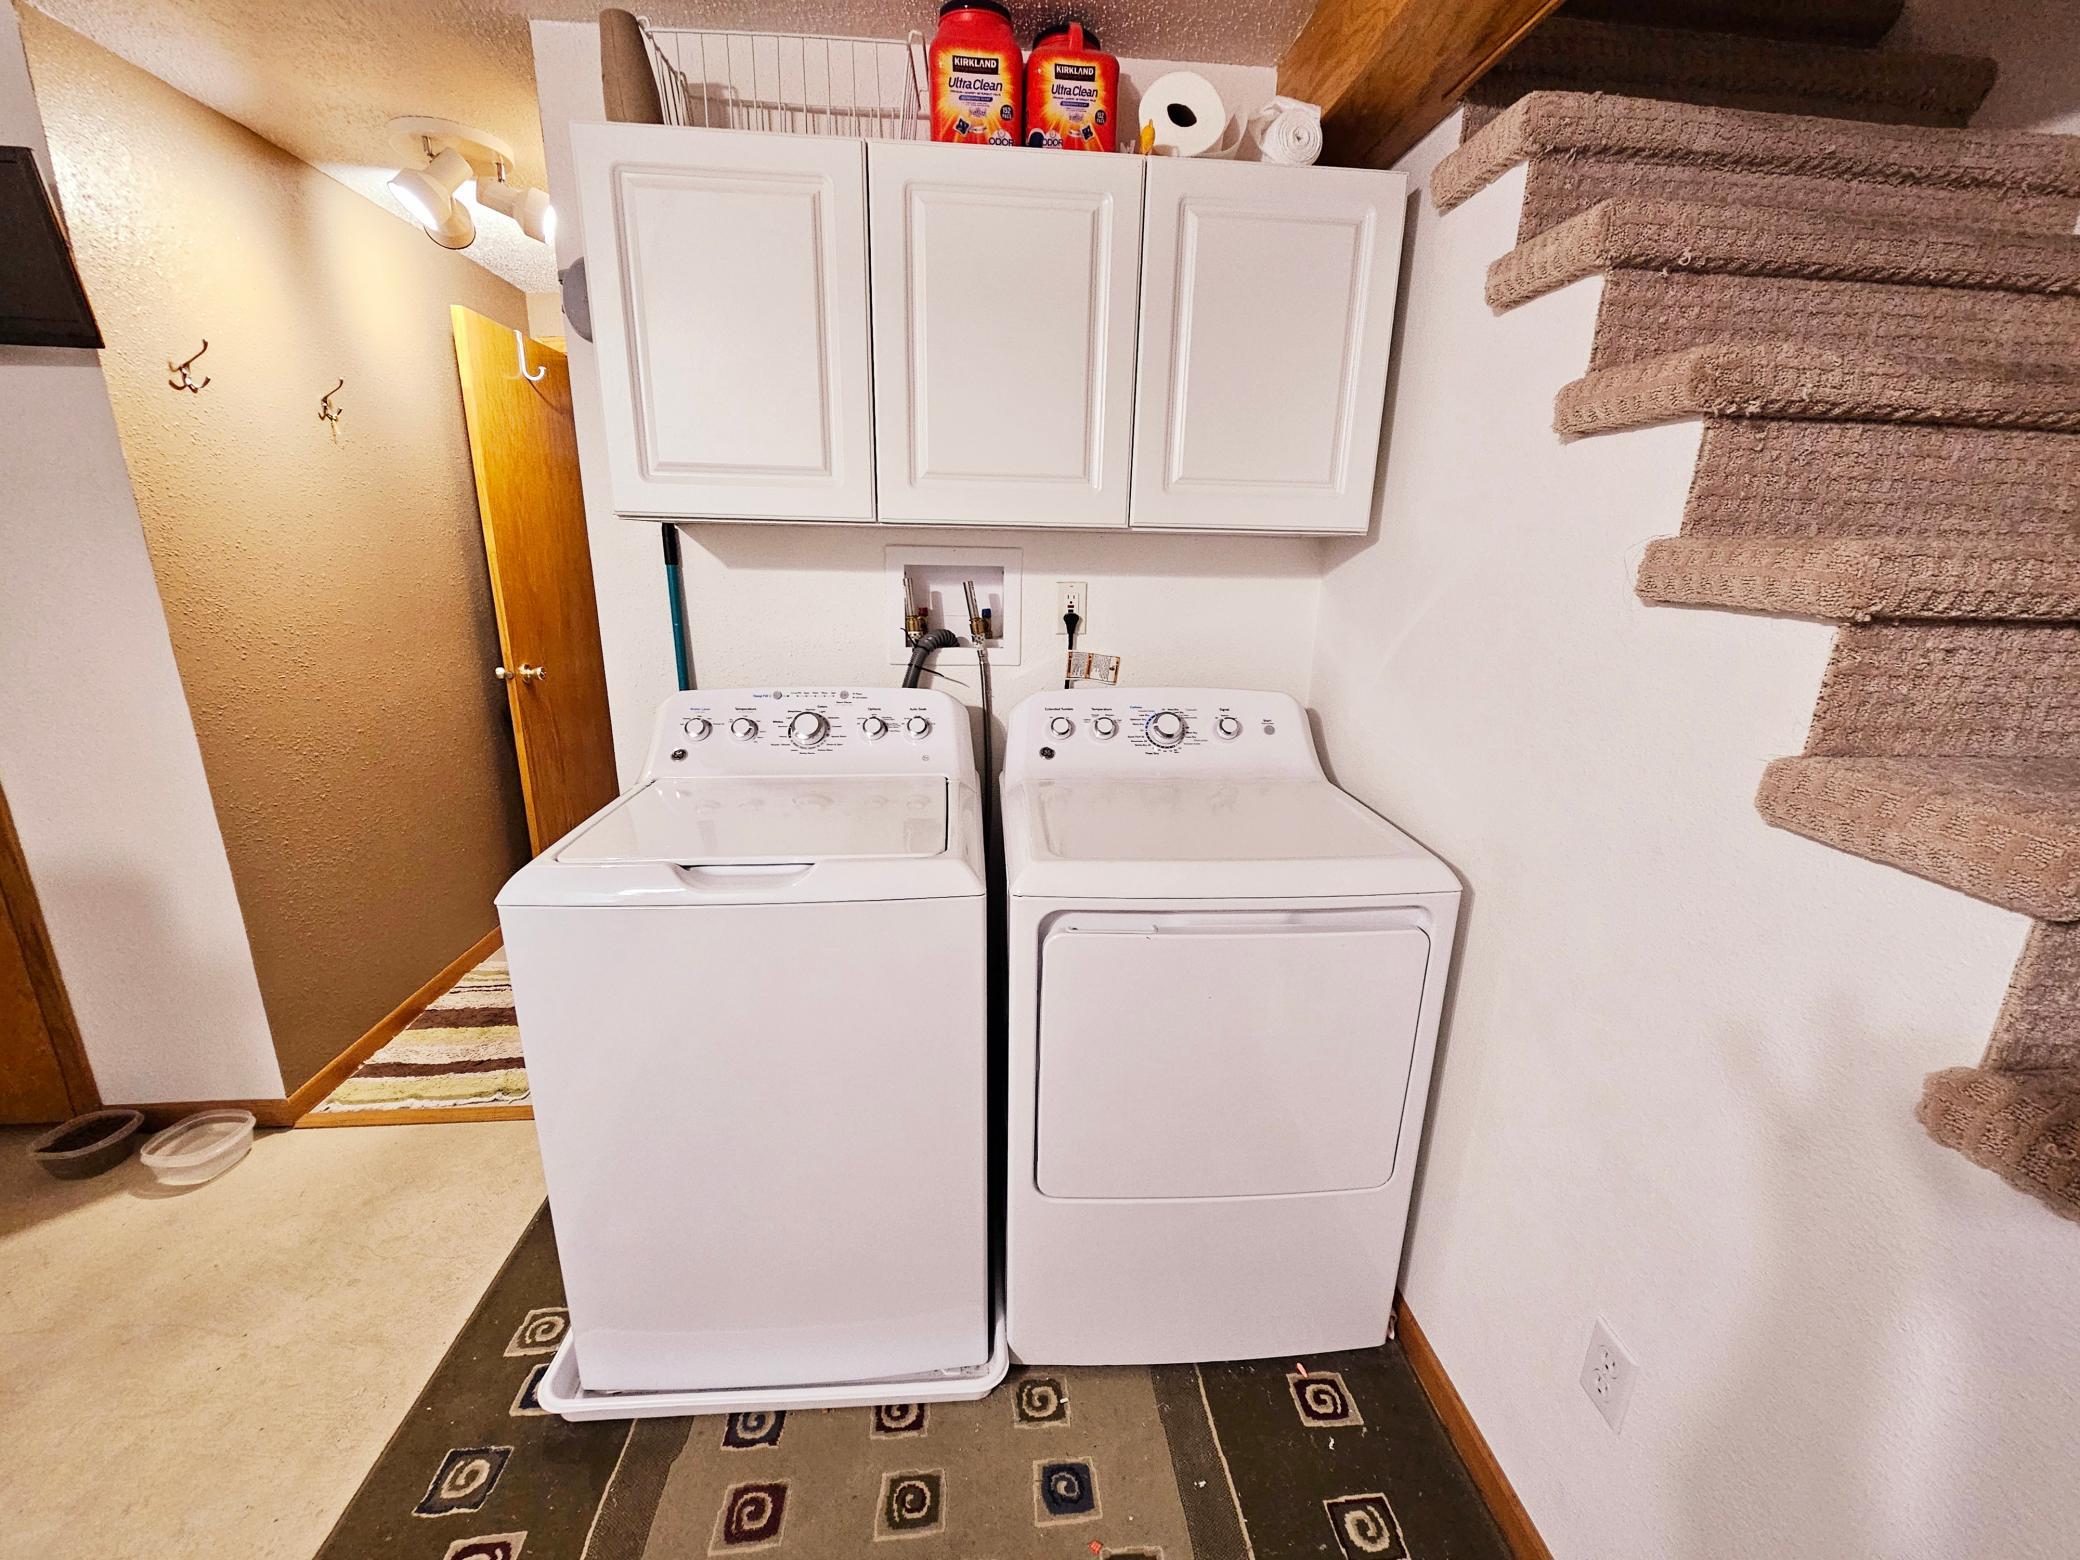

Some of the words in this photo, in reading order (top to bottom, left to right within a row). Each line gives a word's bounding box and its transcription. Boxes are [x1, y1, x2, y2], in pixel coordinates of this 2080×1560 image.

[954, 57, 997, 69] KIRKLAND
[1056, 65, 1094, 76] KIRKLAND
[948, 76, 973, 90] Ultra
[972, 78, 1003, 92] Clean
[1051, 83, 1072, 96] Ultra
[1072, 85, 1099, 98] Clean
[988, 136, 1014, 147] ODOR
